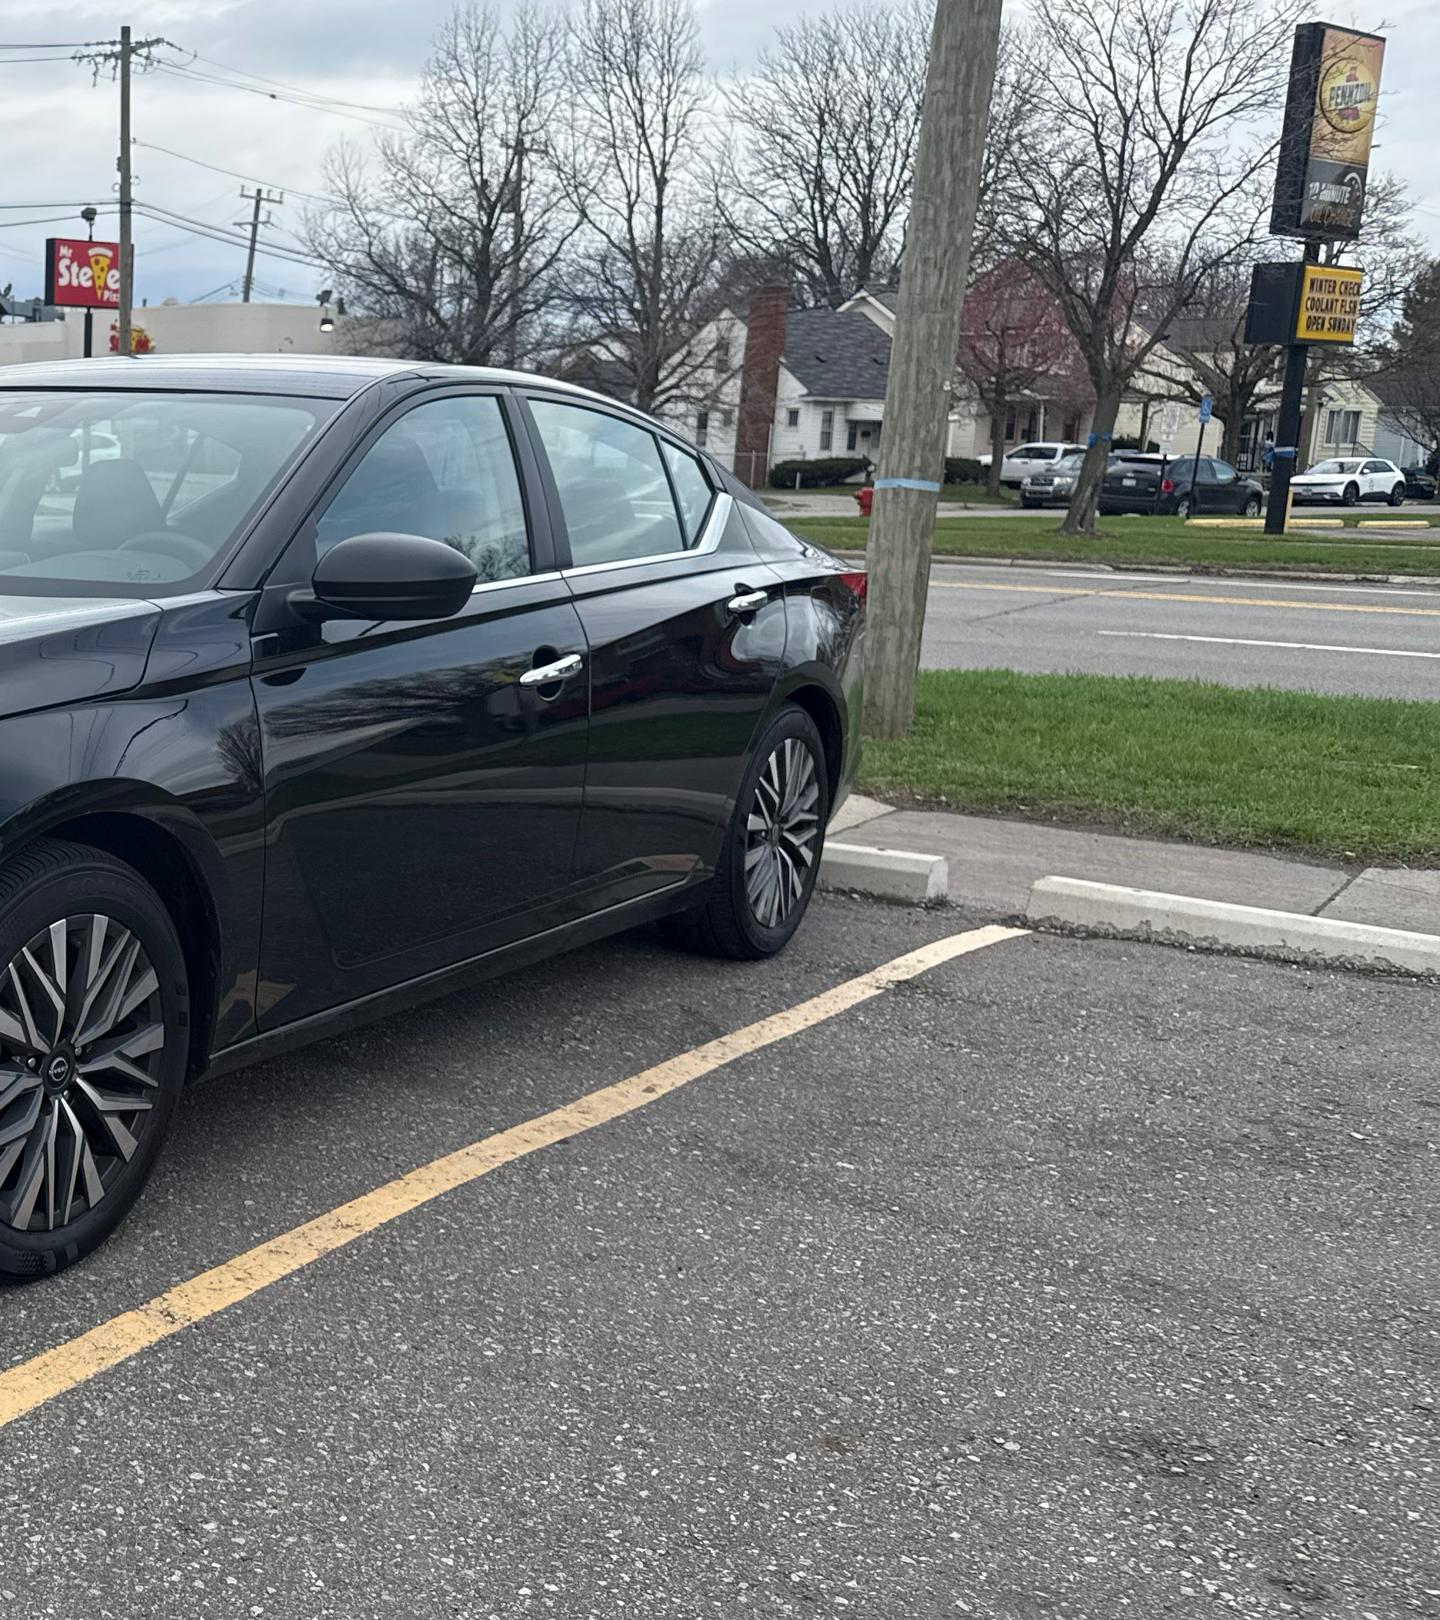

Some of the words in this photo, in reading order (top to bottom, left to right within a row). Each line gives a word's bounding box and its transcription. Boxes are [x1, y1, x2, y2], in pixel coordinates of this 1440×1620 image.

[1310, 278, 1337, 294] WINTER
[1305, 297, 1339, 313] COOLANT
[1306, 315, 1326, 331] OPEN
[1327, 317, 1357, 334] SUNDAY
